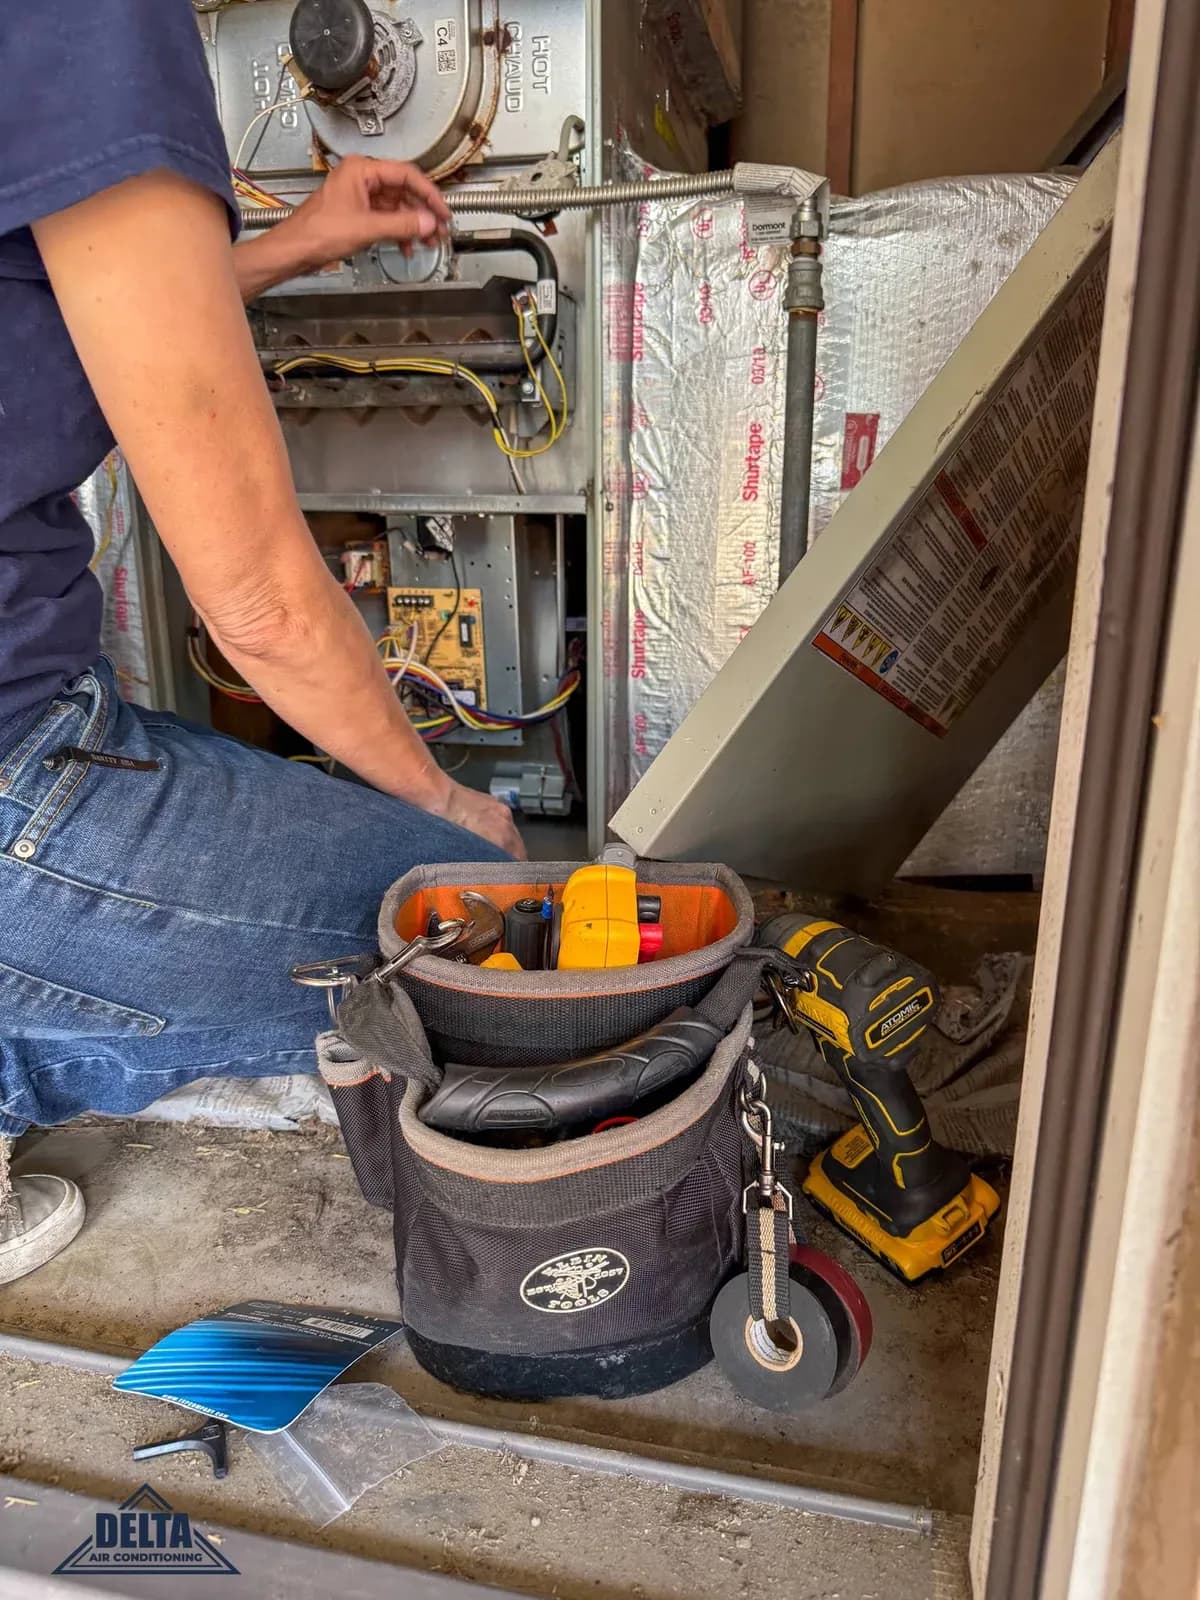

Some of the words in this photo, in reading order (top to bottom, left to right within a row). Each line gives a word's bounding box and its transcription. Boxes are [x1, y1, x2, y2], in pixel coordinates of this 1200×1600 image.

[437, 27, 449, 47] C4
[531, 35, 552, 96] HOT
[742, 422, 765, 502] Shurtape
[742, 541, 757, 588] AF-100
[110, 566, 130, 633] Shurtape
[631, 609, 648, 680] Shurtape
[879, 999, 919, 1032] ATOMIC
[547, 1288, 610, 1309] TOOLS
